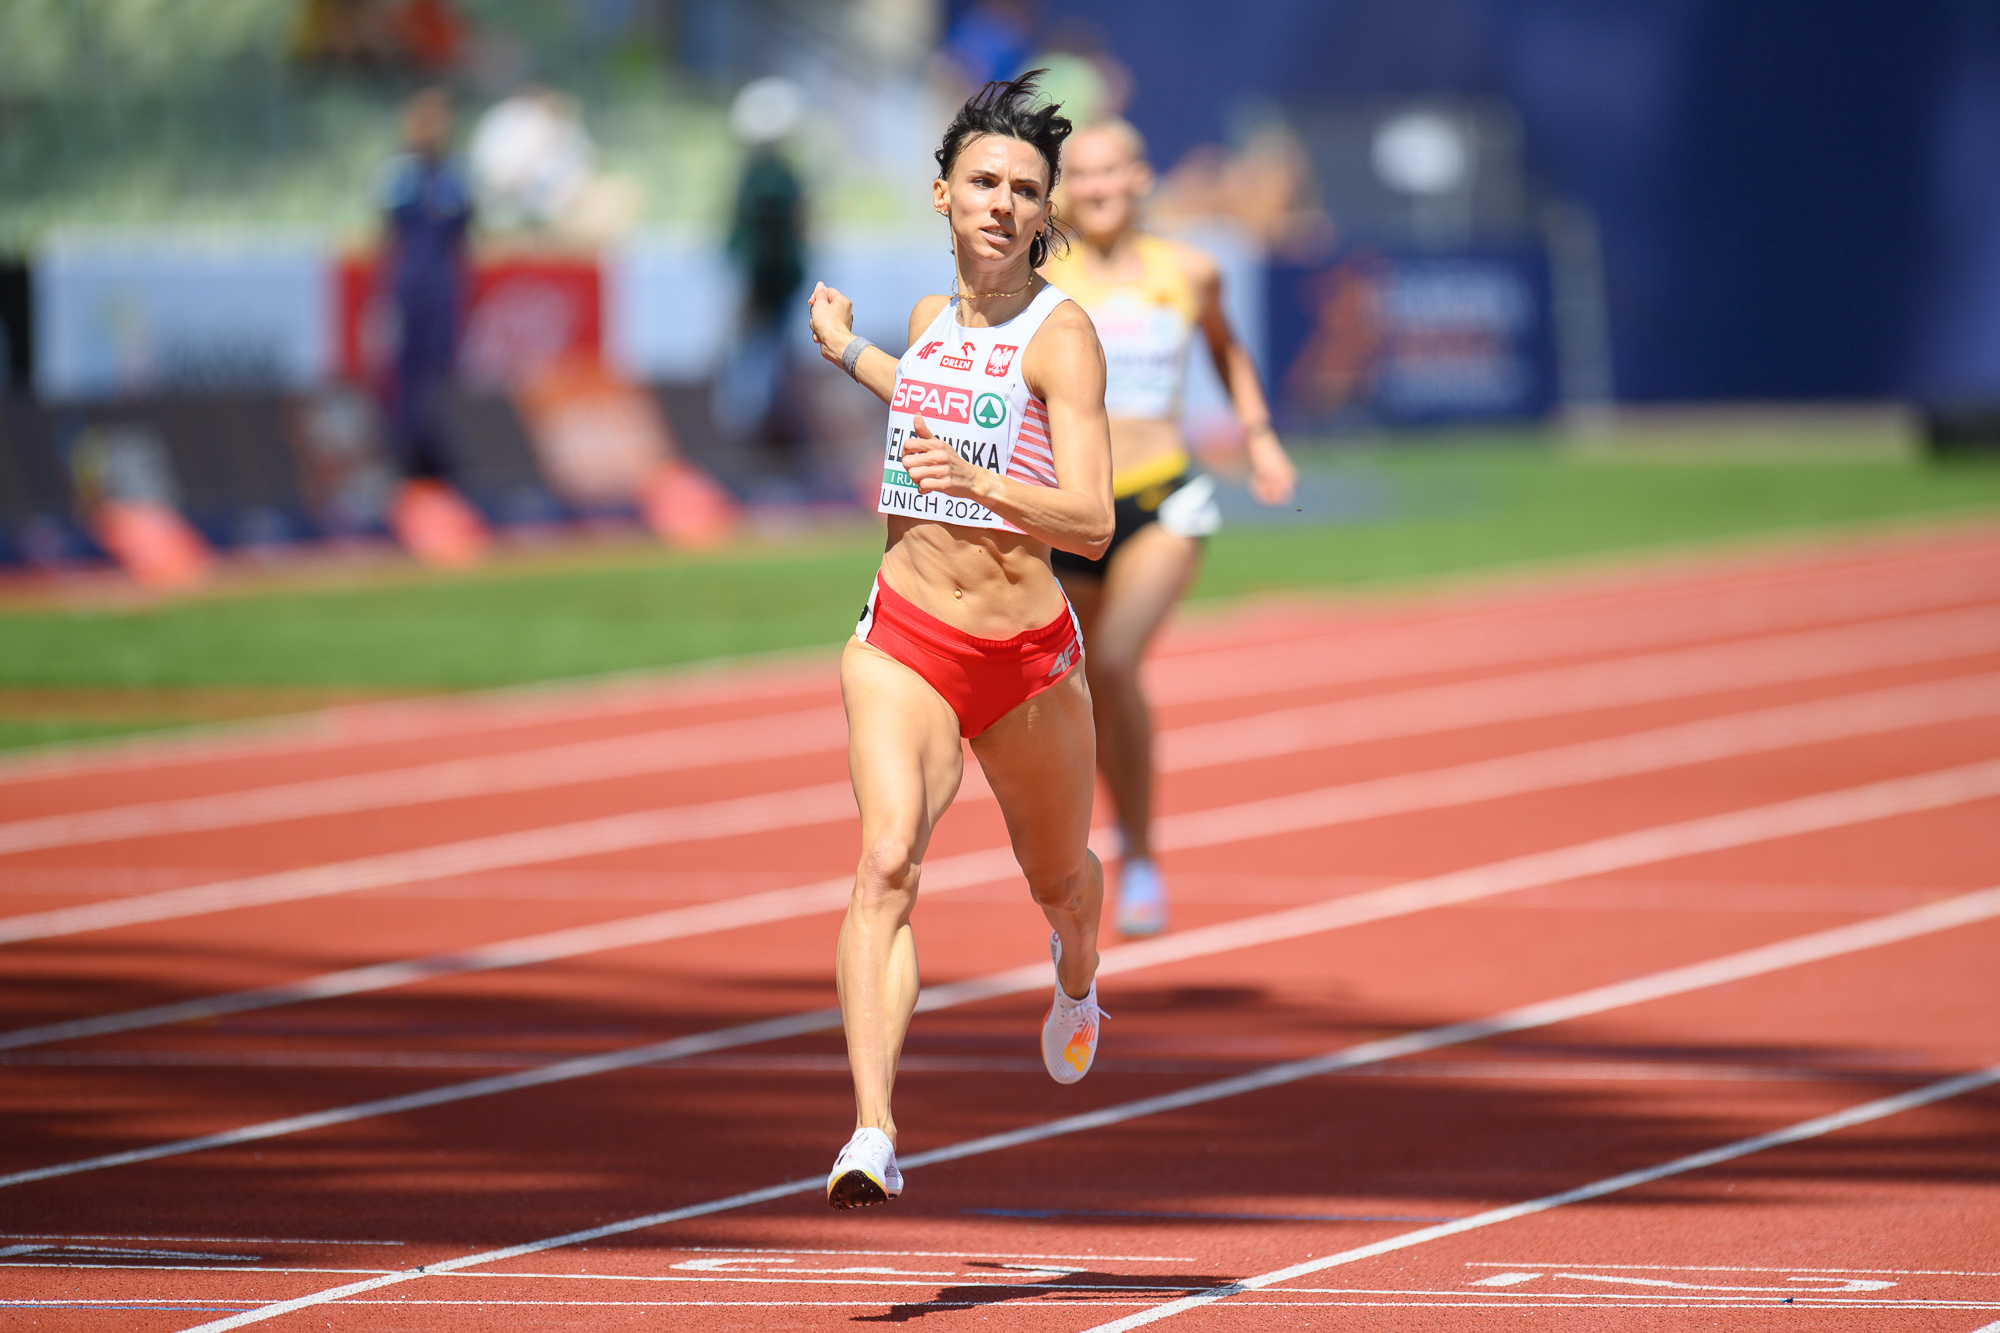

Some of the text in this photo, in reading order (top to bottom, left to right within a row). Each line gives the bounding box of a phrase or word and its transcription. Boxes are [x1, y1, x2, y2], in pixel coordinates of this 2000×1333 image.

[942, 357, 970, 370] ORLEN
[893, 383, 968, 419] SPAR
[896, 473, 917, 487] RU
[945, 499, 993, 521] 2022
